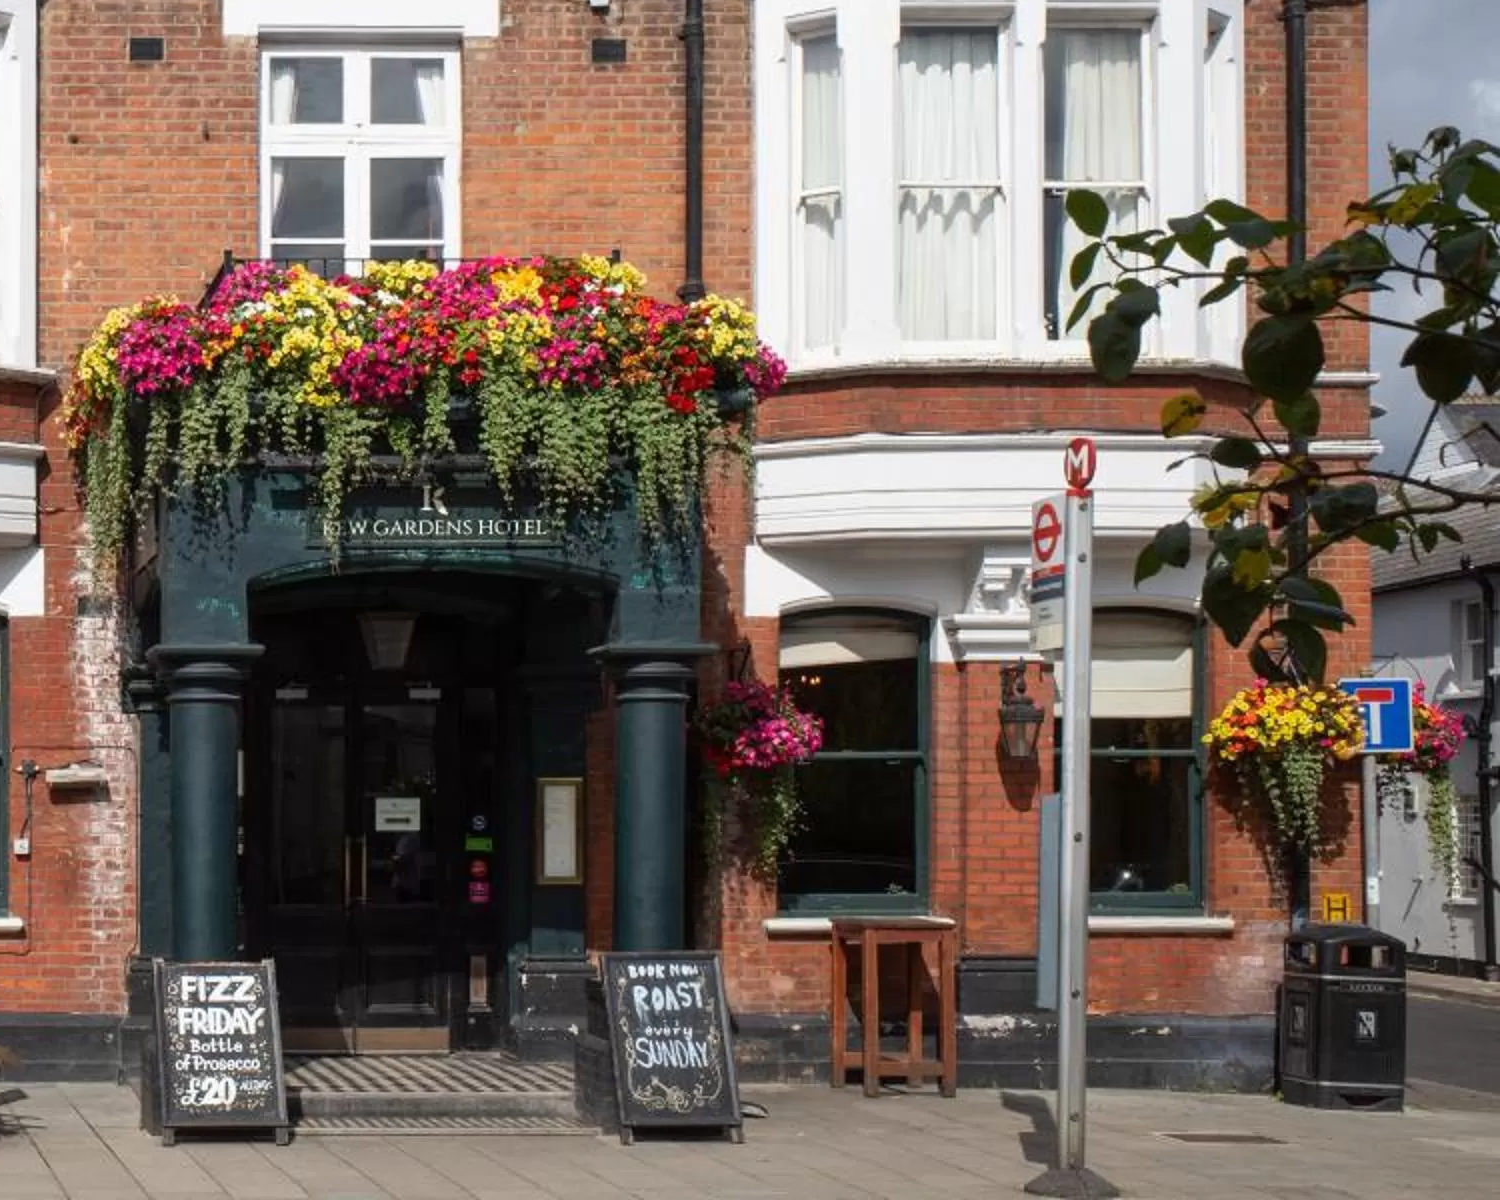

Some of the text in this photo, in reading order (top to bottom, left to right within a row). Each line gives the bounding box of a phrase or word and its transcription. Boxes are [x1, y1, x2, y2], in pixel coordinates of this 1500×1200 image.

[1067, 444, 1089, 481] M
[373, 518, 473, 538] GARDENS
[478, 519, 547, 537] HOTEL
[627, 963, 665, 979] BOOK
[181, 975, 257, 1002] FIZZ
[632, 981, 703, 1014] ROAST
[177, 1007, 267, 1036] FRIDAY
[190, 1037, 243, 1053] Bottle
[635, 1037, 709, 1069] SUNDAY
[175, 1053, 261, 1071] of Prosecco
[181, 1076, 238, 1106] £20
